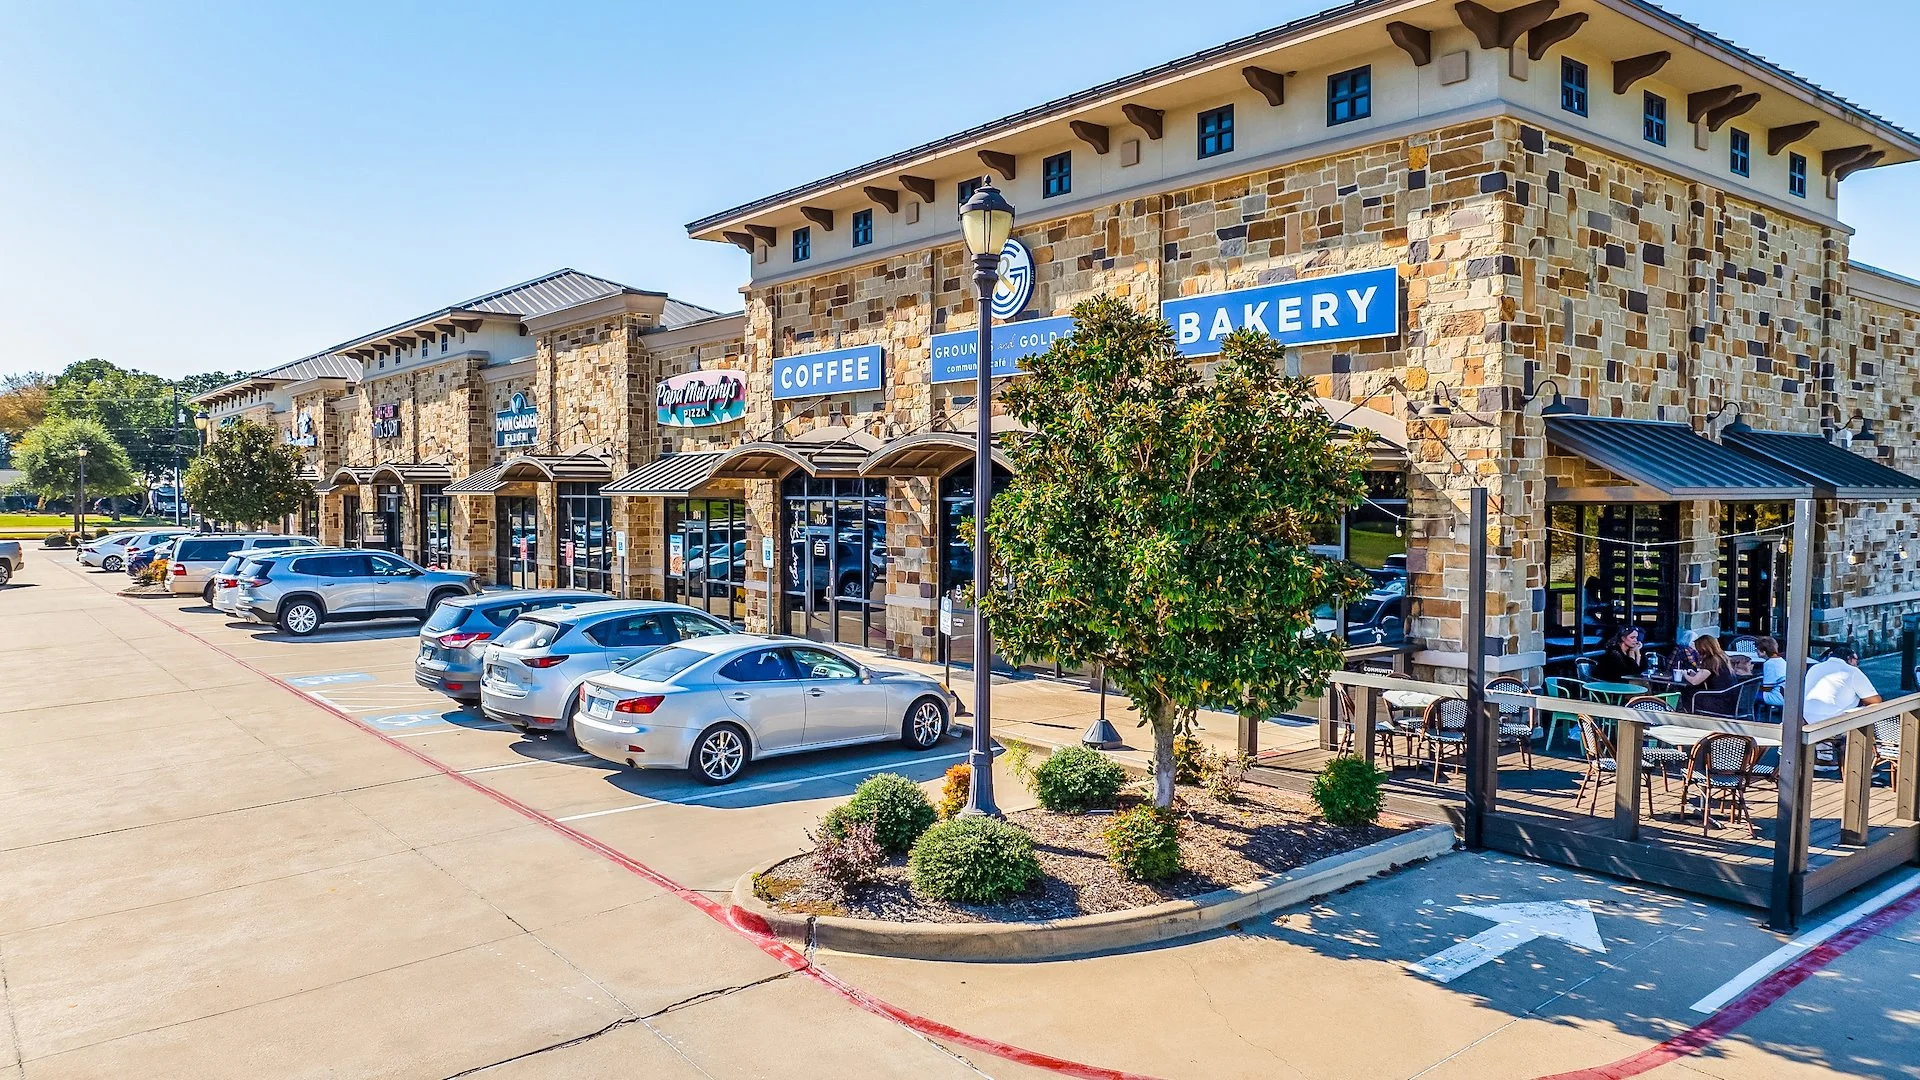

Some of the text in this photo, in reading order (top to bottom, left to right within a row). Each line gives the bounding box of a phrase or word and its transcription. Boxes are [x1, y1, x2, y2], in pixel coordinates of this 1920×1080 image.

[1179, 286, 1378, 344] BAKERY
[935, 341, 994, 359] GROUNS
[1019, 331, 1057, 348] GOLD
[781, 356, 870, 389] COFFEE
[656, 375, 738, 415] Papa Murphy's
[683, 407, 707, 418] PIZZA
